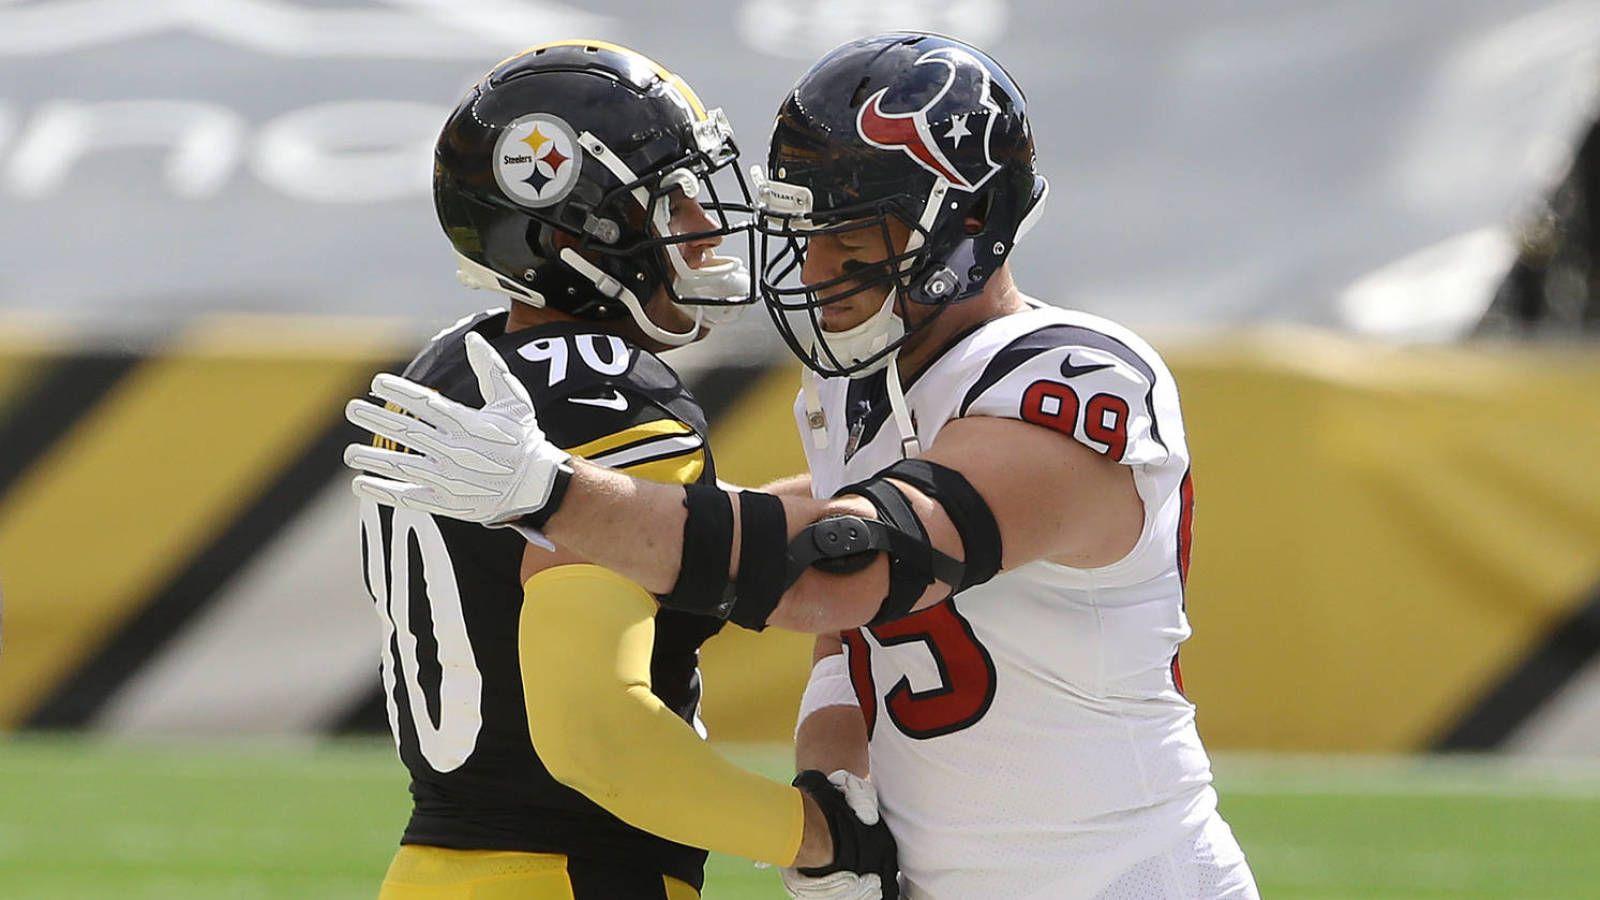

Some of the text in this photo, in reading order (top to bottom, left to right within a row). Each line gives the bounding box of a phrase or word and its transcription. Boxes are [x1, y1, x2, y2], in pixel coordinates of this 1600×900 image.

[504, 154, 532, 165] Steelers
[516, 333, 630, 387] 90
[1020, 379, 1129, 463] 99
